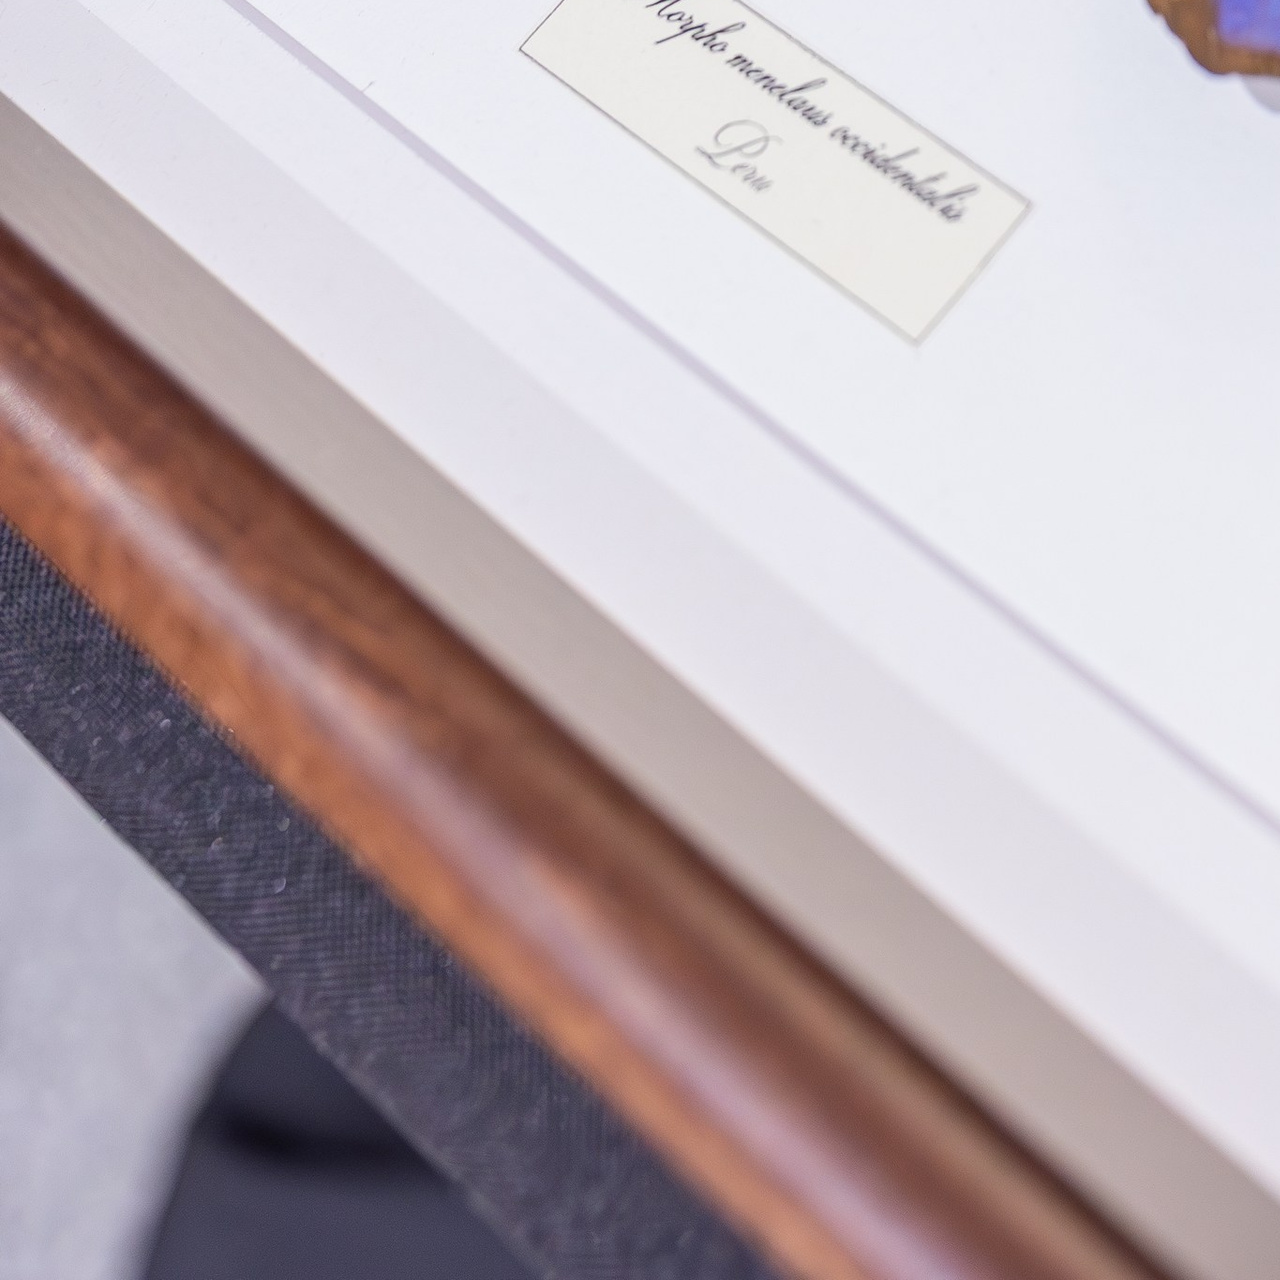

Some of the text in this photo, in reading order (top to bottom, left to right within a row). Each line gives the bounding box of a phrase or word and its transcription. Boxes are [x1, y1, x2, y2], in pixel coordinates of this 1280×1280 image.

[695, 118, 784, 193] Peru
[725, 53, 832, 127] menelaus
[829, 125, 981, 223] occidentalis
